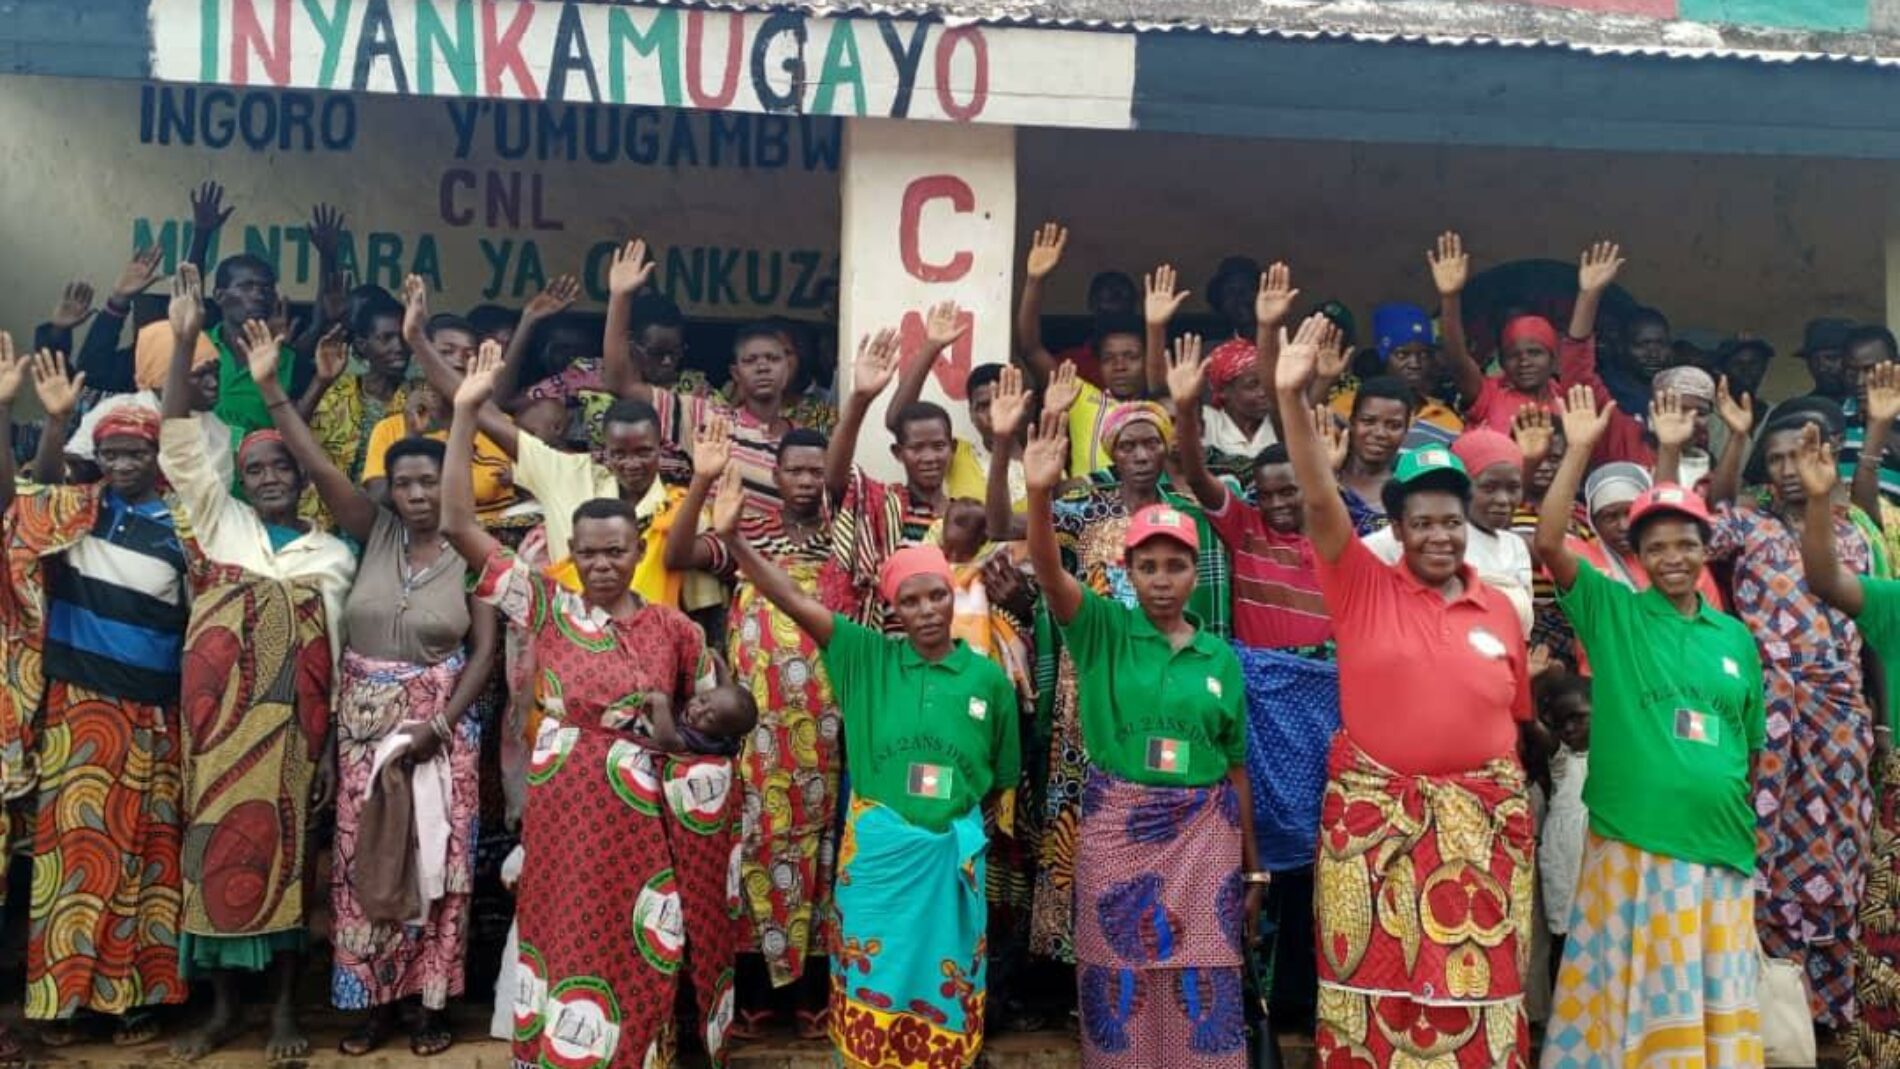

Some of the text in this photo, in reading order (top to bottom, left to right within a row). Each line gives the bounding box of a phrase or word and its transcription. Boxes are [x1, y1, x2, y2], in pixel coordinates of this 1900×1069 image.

[200, 0, 989, 122] INYANKAMUGAYO
[139, 85, 357, 152] INGORO
[438, 168, 565, 231] CNL
[478, 237, 547, 299] YA
